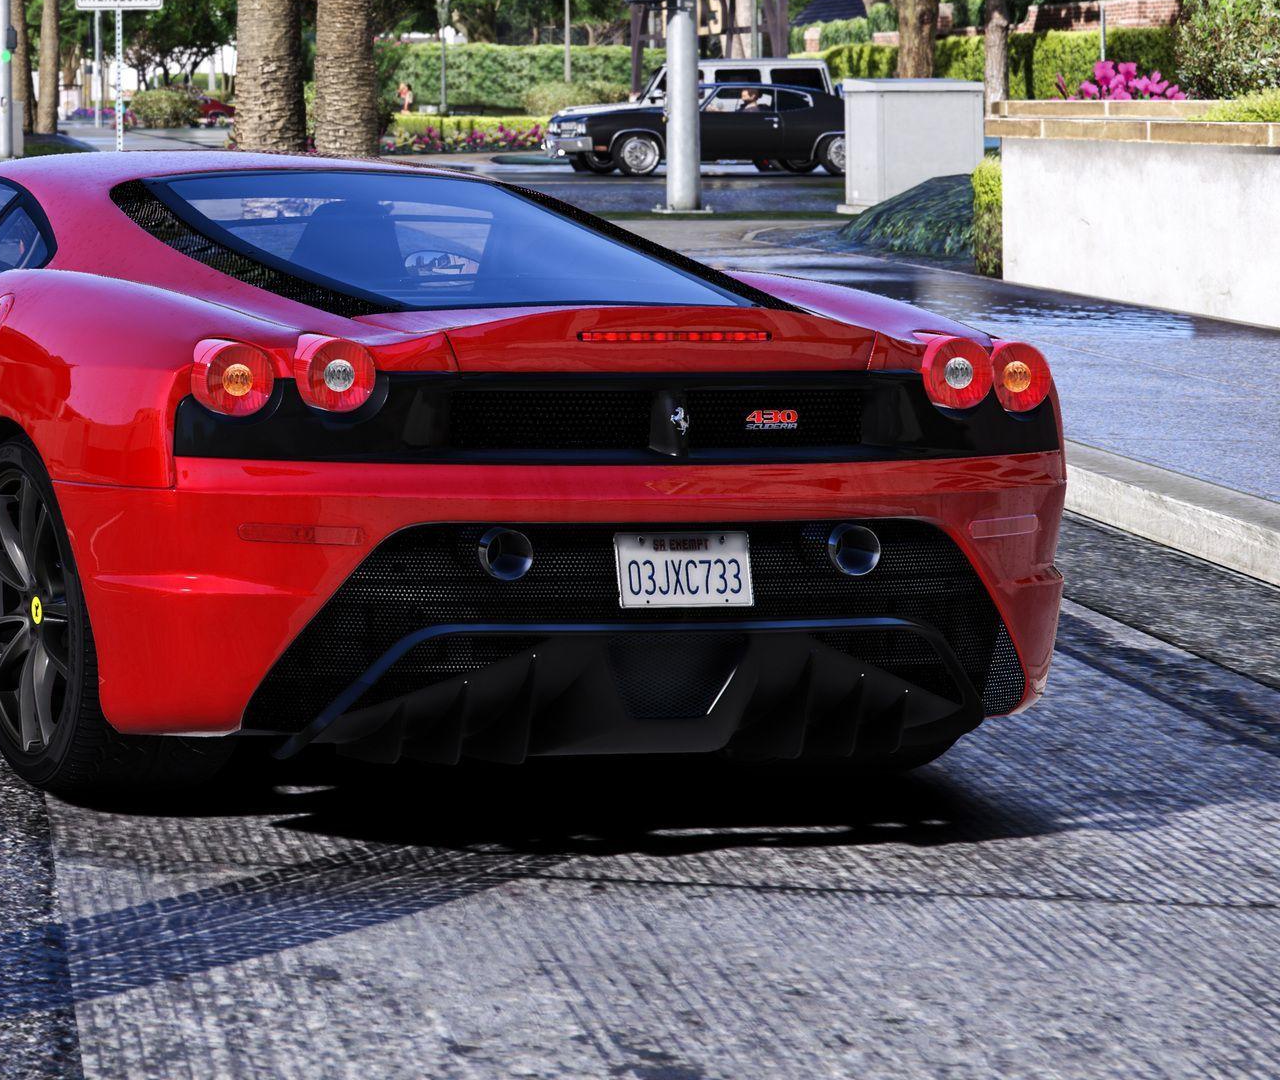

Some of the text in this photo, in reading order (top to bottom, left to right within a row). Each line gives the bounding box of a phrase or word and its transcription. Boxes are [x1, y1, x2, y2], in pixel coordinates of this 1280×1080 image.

[745, 409, 799, 424] 430
[745, 422, 798, 430] SCUDERIA
[628, 558, 742, 596] 03JXC733
